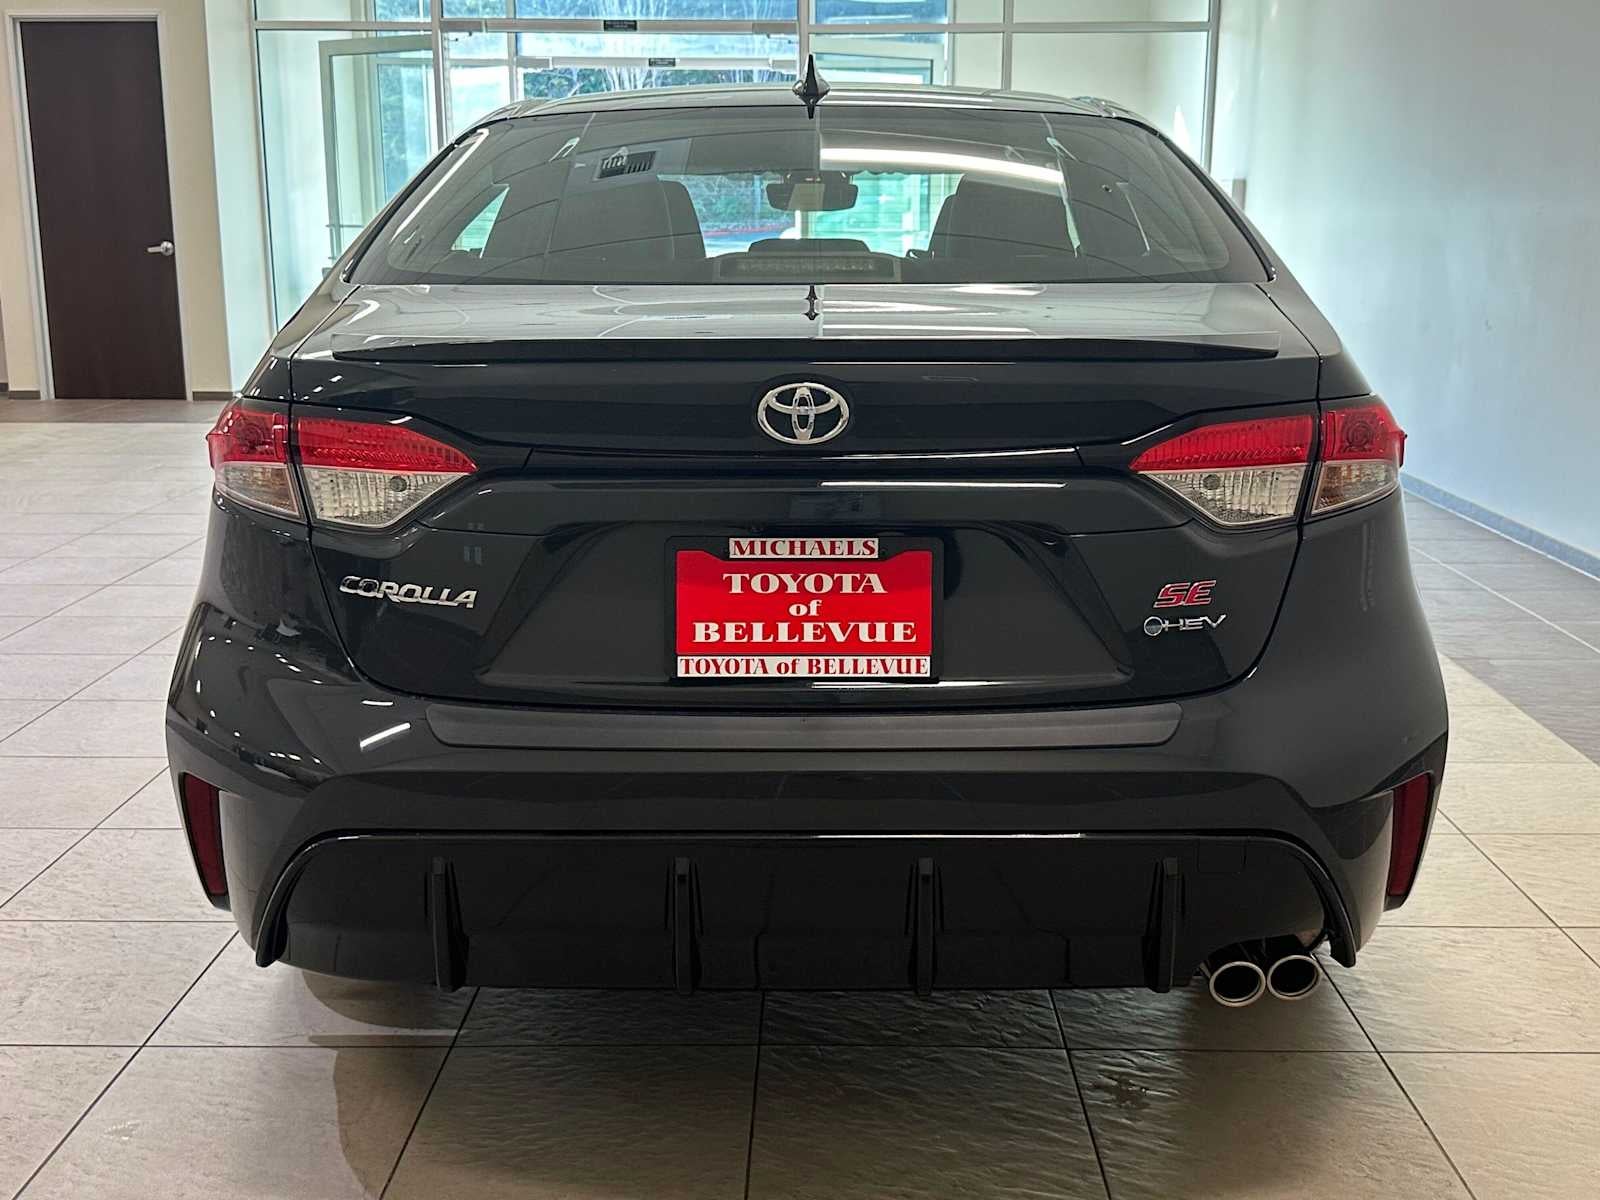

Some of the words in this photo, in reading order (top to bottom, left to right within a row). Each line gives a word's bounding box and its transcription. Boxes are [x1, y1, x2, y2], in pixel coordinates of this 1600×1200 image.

[732, 540, 876, 556] MICHAELS
[339, 576, 478, 609] COROLLA
[723, 573, 888, 594] TOYOTA
[1153, 580, 1217, 608] SE
[788, 599, 823, 617] of
[693, 622, 917, 643] BELLEVUE
[680, 658, 769, 675] TOYOTA
[776, 658, 800, 675] of
[807, 658, 928, 675] BELLEVUE
